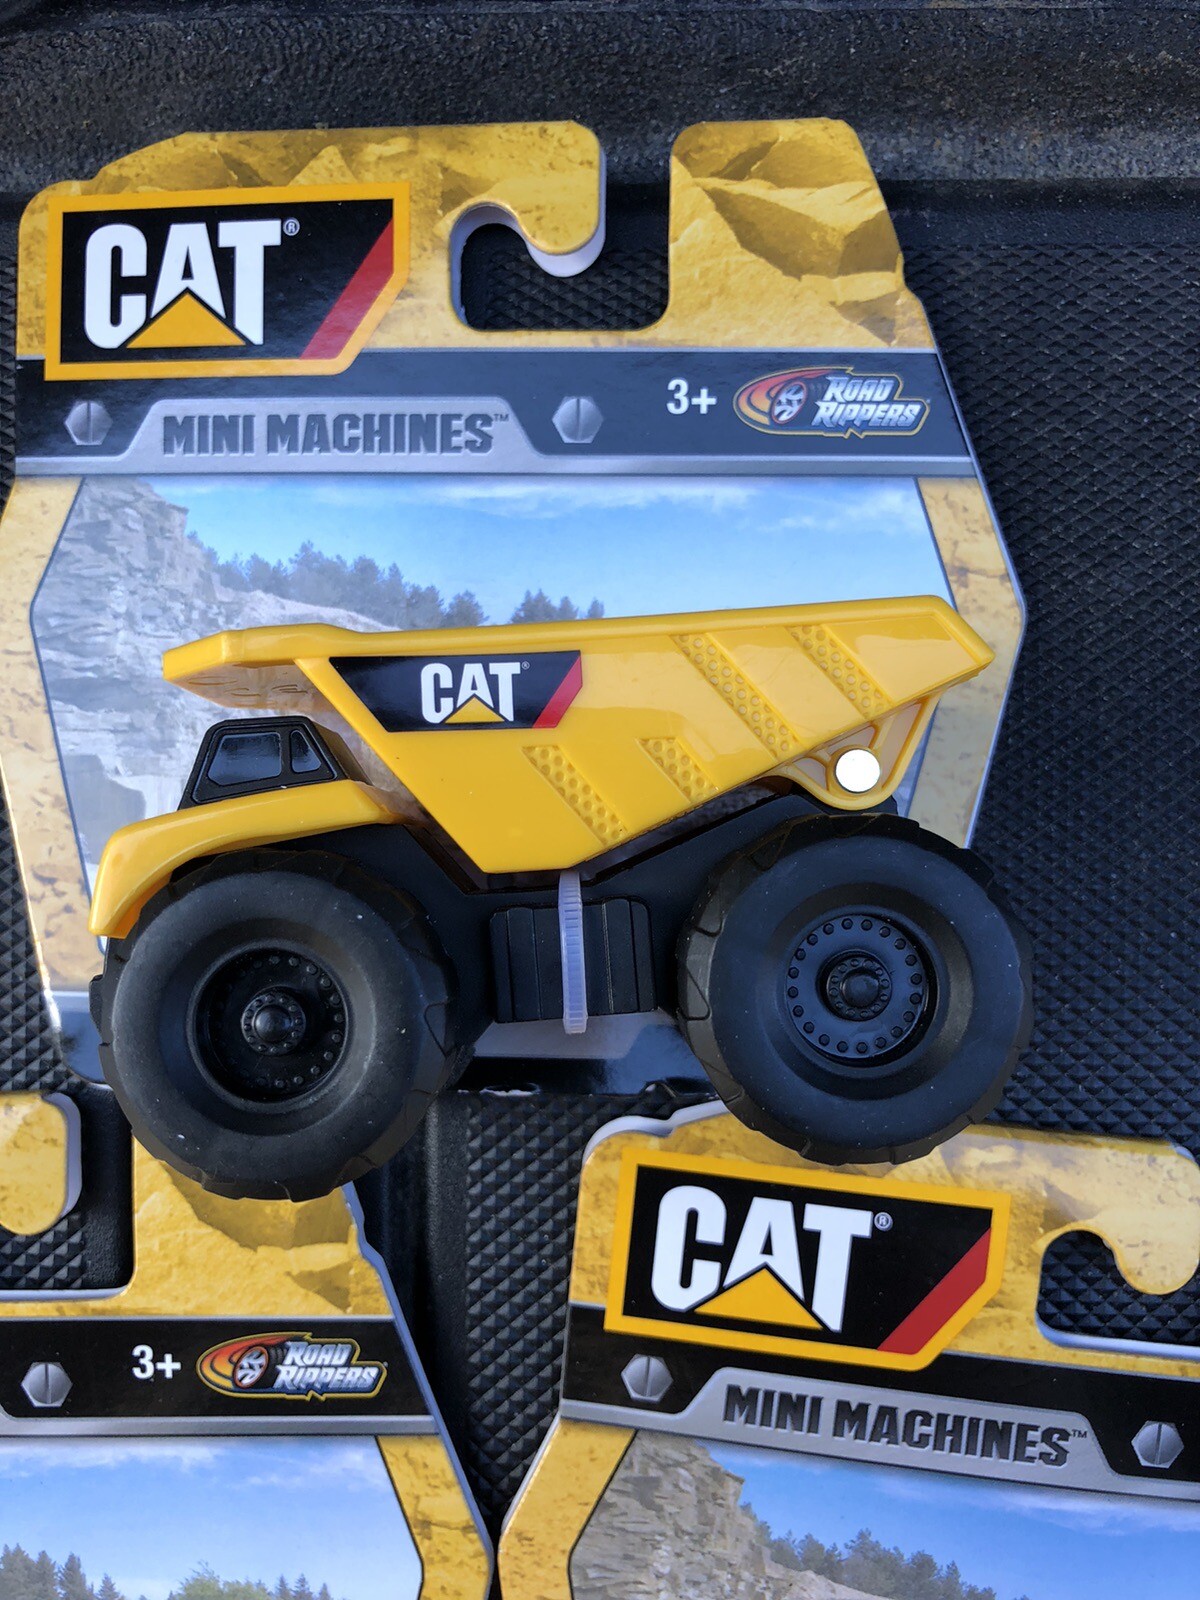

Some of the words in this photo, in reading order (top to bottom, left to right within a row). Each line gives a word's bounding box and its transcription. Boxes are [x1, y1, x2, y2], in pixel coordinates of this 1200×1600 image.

[85, 219, 282, 349] CAT
[667, 377, 717, 415] 3+
[823, 376, 896, 401] ROAD
[811, 400, 922, 427] RIPPERS
[163, 413, 256, 455] MINI
[266, 412, 496, 455] MACHINES
[420, 662, 521, 724] CAT
[651, 1185, 873, 1333] CAT
[131, 1344, 181, 1380] 3+
[283, 1341, 351, 1366] ROAD
[273, 1365, 380, 1389] RIPPERS
[723, 1385, 823, 1435] MINI
[833, 1400, 1072, 1467] MACHINES
